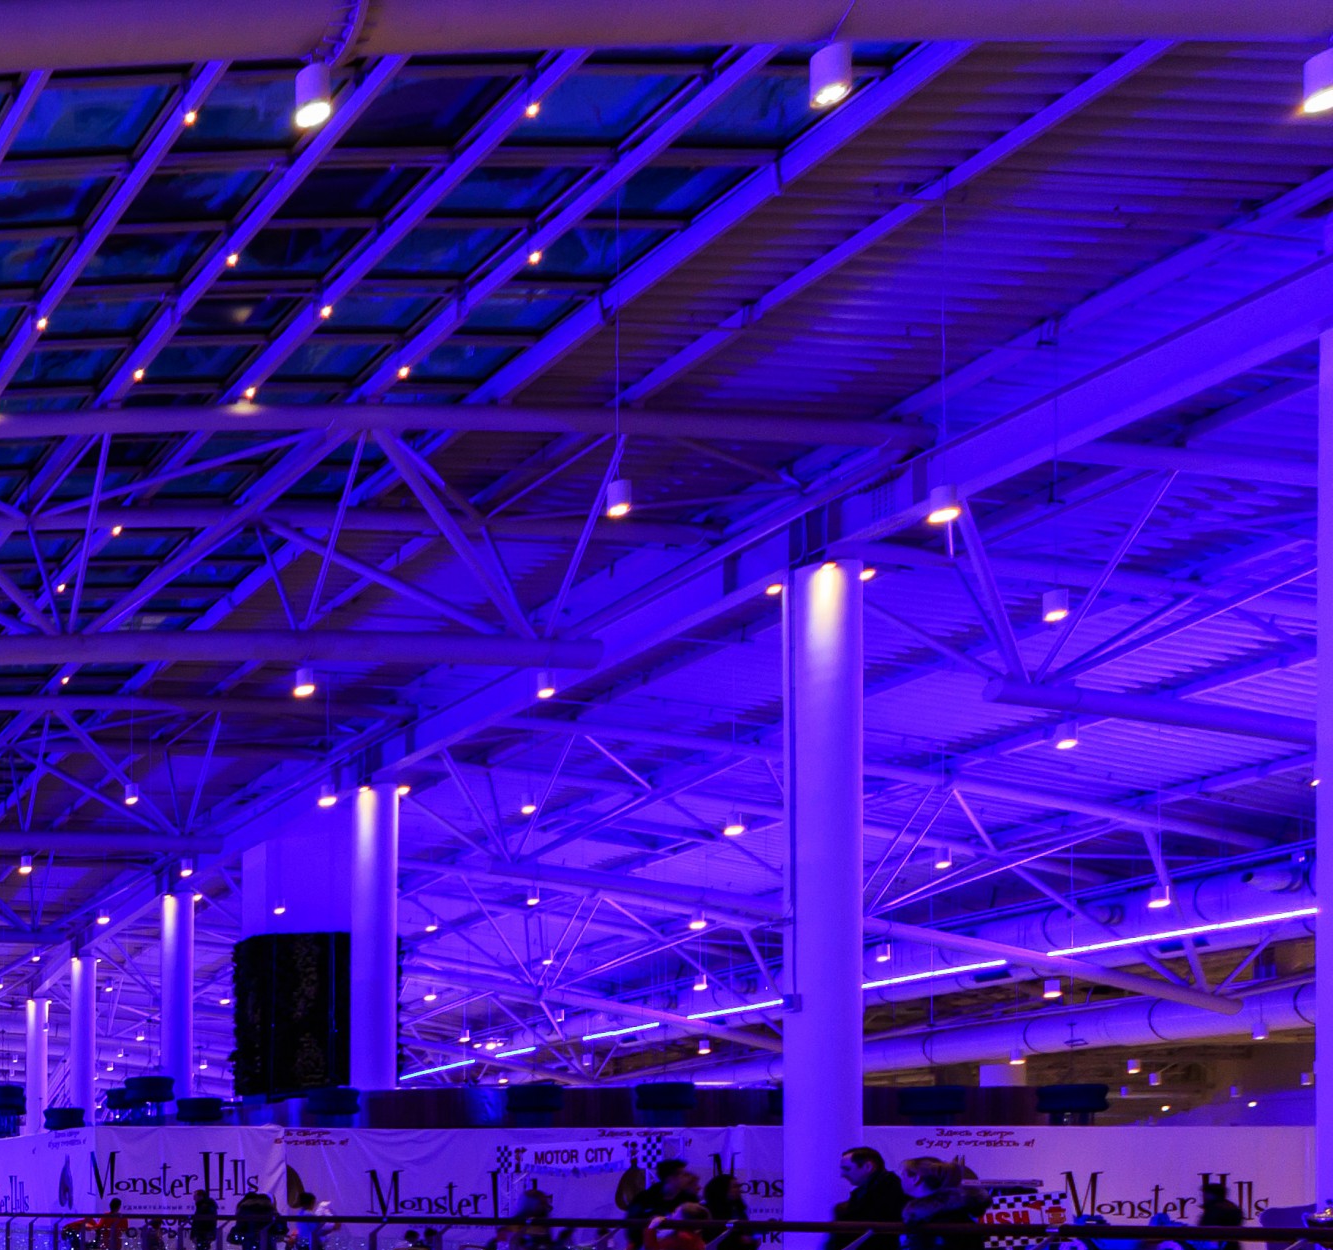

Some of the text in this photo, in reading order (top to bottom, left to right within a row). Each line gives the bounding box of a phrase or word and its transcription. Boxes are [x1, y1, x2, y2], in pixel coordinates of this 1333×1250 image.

[87, 1151, 260, 1201] Monster Hills
[534, 1148, 614, 1165] MOTOR CITY
[365, 1169, 488, 1217] Monster
[1060, 1171, 1196, 1219] Monster
